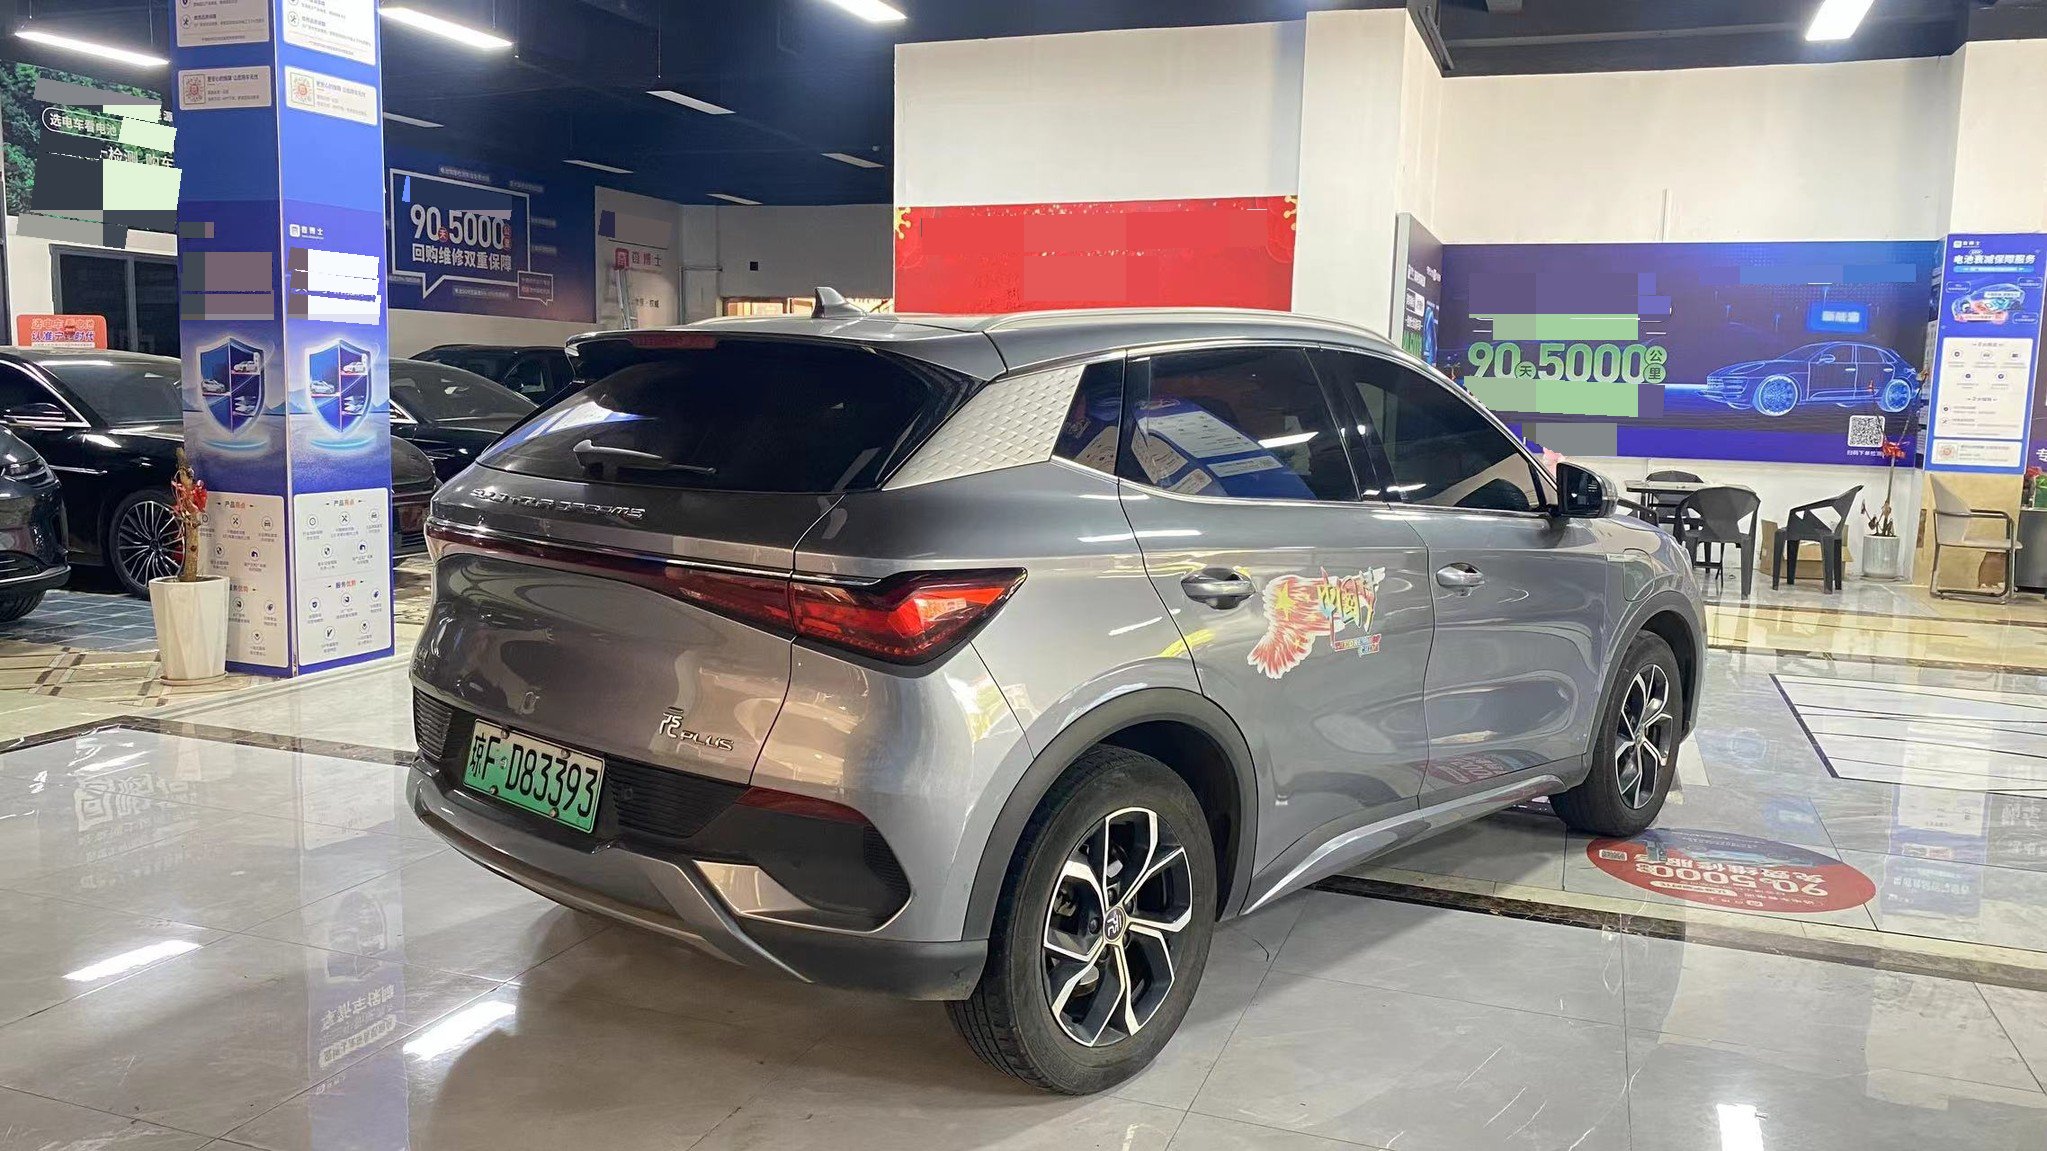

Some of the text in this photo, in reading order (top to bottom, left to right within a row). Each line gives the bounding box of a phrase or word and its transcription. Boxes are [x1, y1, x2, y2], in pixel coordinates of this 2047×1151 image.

[50, 113, 117, 137] 选电车看电池
[412, 243, 512, 272] 回购维修双重保障
[31, 330, 95, 342] 认准宁时代
[680, 730, 734, 751] PLUS
